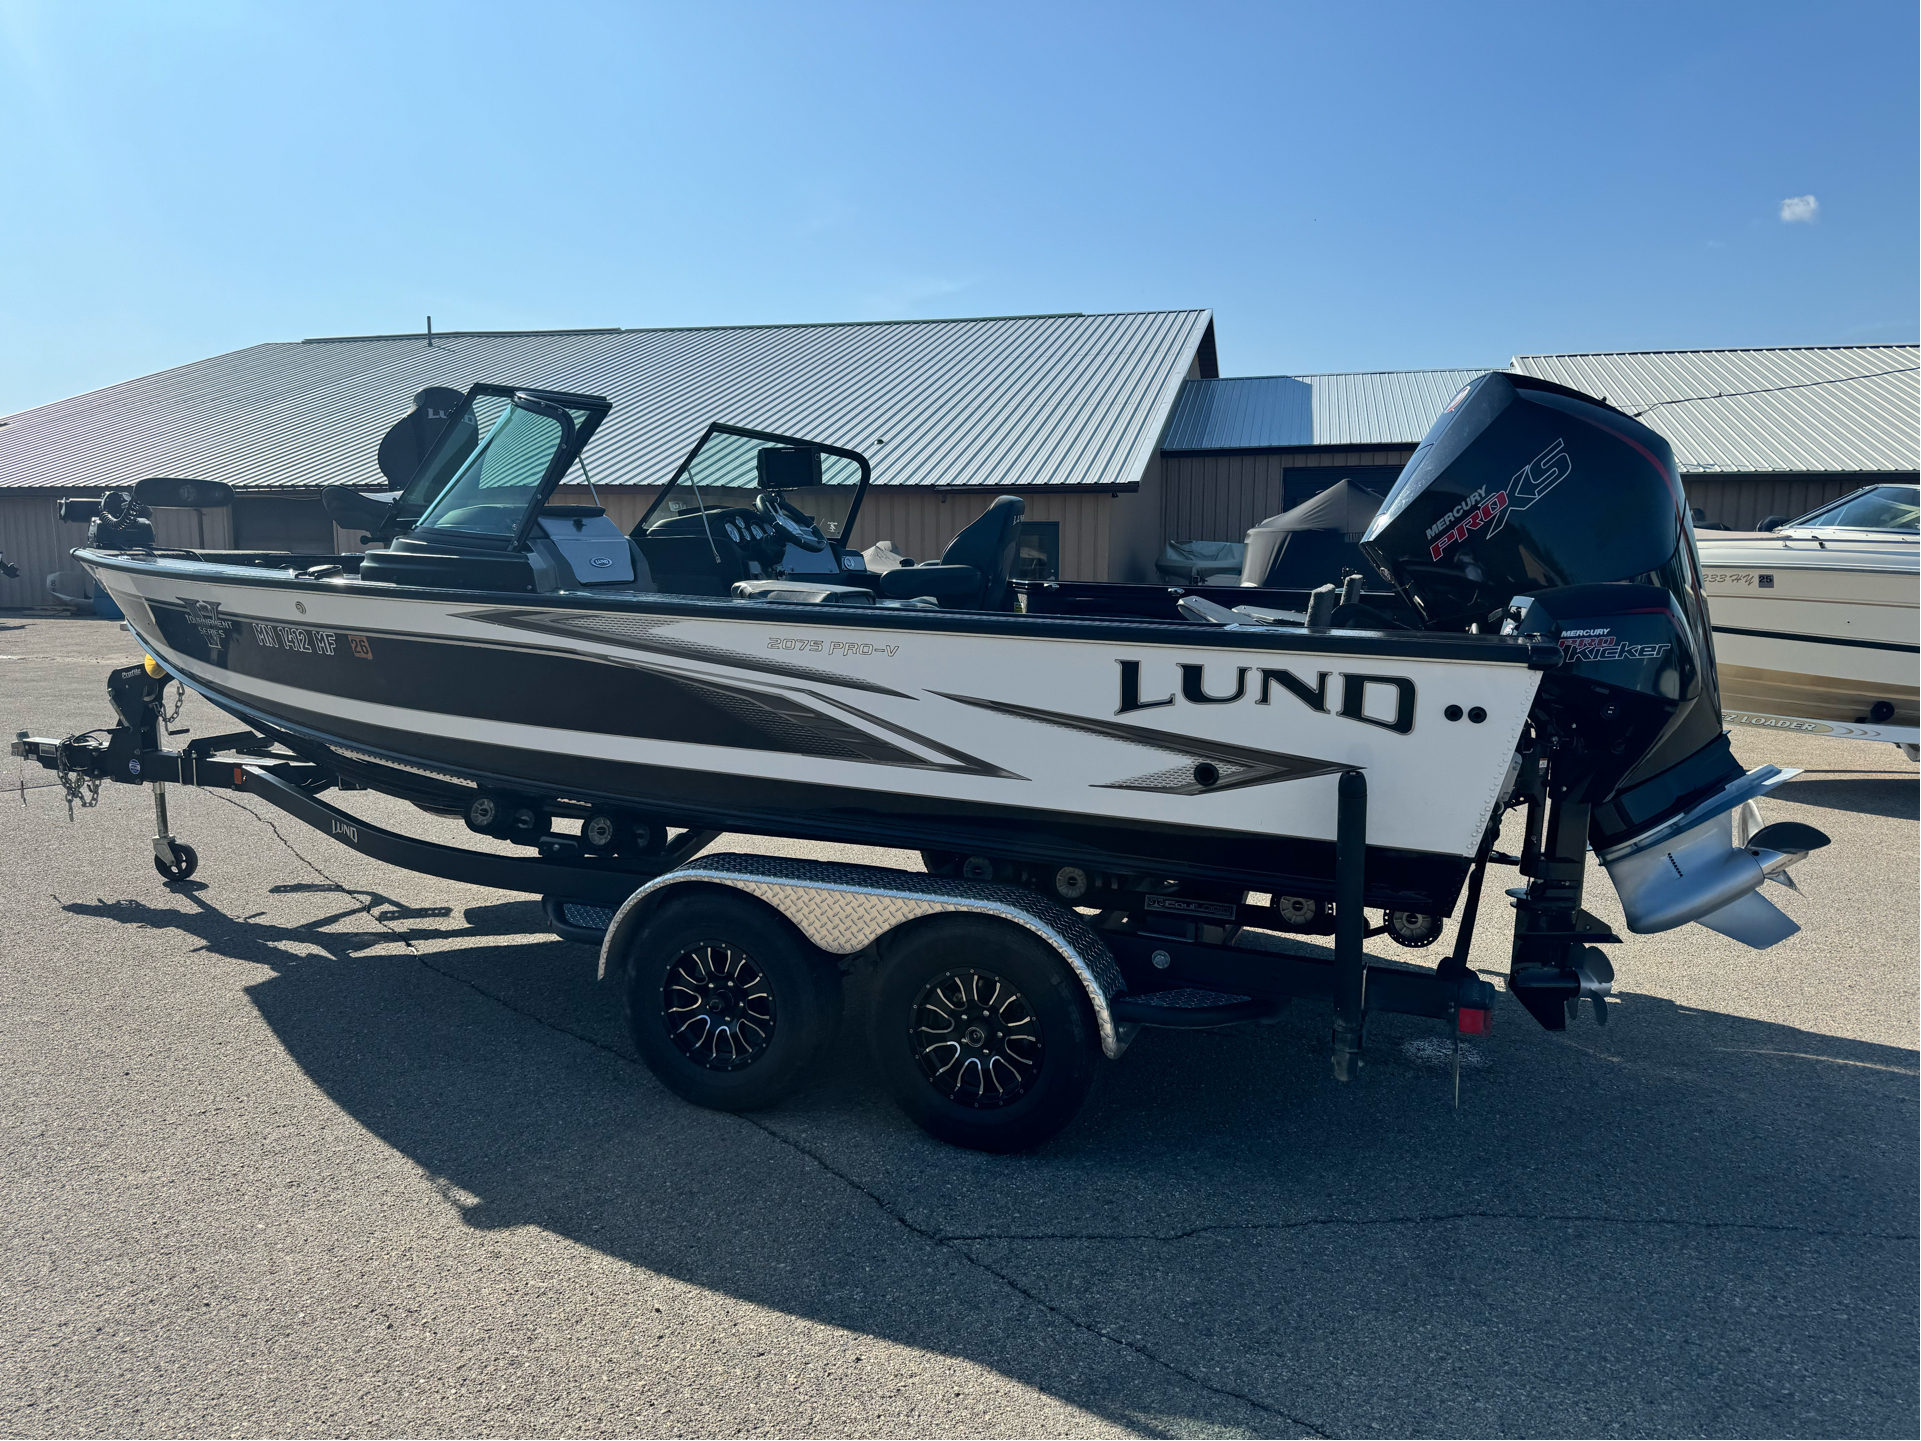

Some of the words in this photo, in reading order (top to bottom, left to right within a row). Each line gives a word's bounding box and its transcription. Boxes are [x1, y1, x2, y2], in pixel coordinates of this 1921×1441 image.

[427, 408, 475, 426] LUD
[1425, 484, 1487, 540] MERCURY
[1729, 573, 1754, 586] HY
[1758, 574, 1772, 584] 25
[184, 614, 233, 630] TOURNAMENT
[198, 626, 226, 639] SERIES
[252, 623, 279, 648] MN
[277, 626, 313, 653] 1412
[312, 630, 336, 656] MF
[1561, 628, 1611, 638] MERCURY
[350, 638, 369, 656] 26
[767, 637, 824, 653] 2075
[828, 641, 899, 657] PRO-V
[1558, 636, 1616, 649] PRO
[1114, 659, 1418, 735] LUND
[1740, 715, 1817, 732] LOADER
[332, 819, 358, 844] LUND
